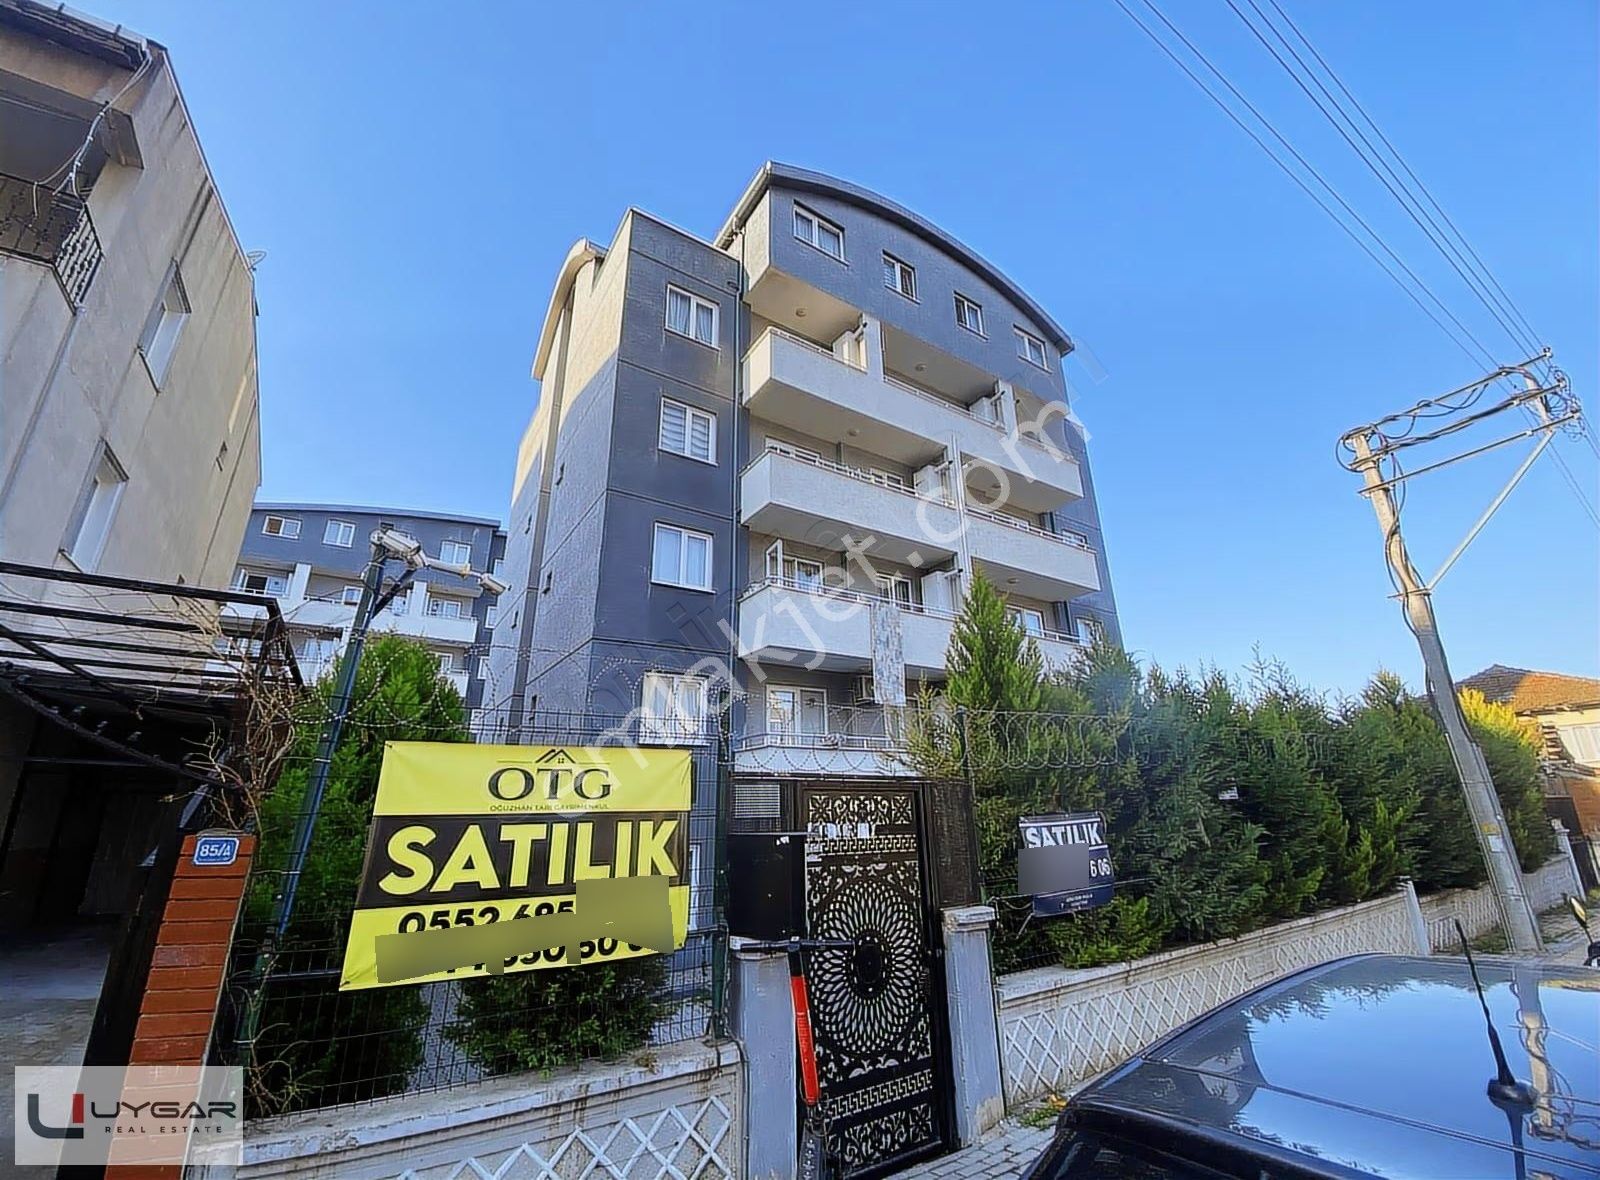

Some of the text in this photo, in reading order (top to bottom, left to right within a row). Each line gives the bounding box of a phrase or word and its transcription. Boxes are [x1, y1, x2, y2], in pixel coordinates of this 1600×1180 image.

[488, 767, 611, 801] OTG
[1025, 822, 1103, 848] SATILIK
[378, 820, 679, 895] SATILIK
